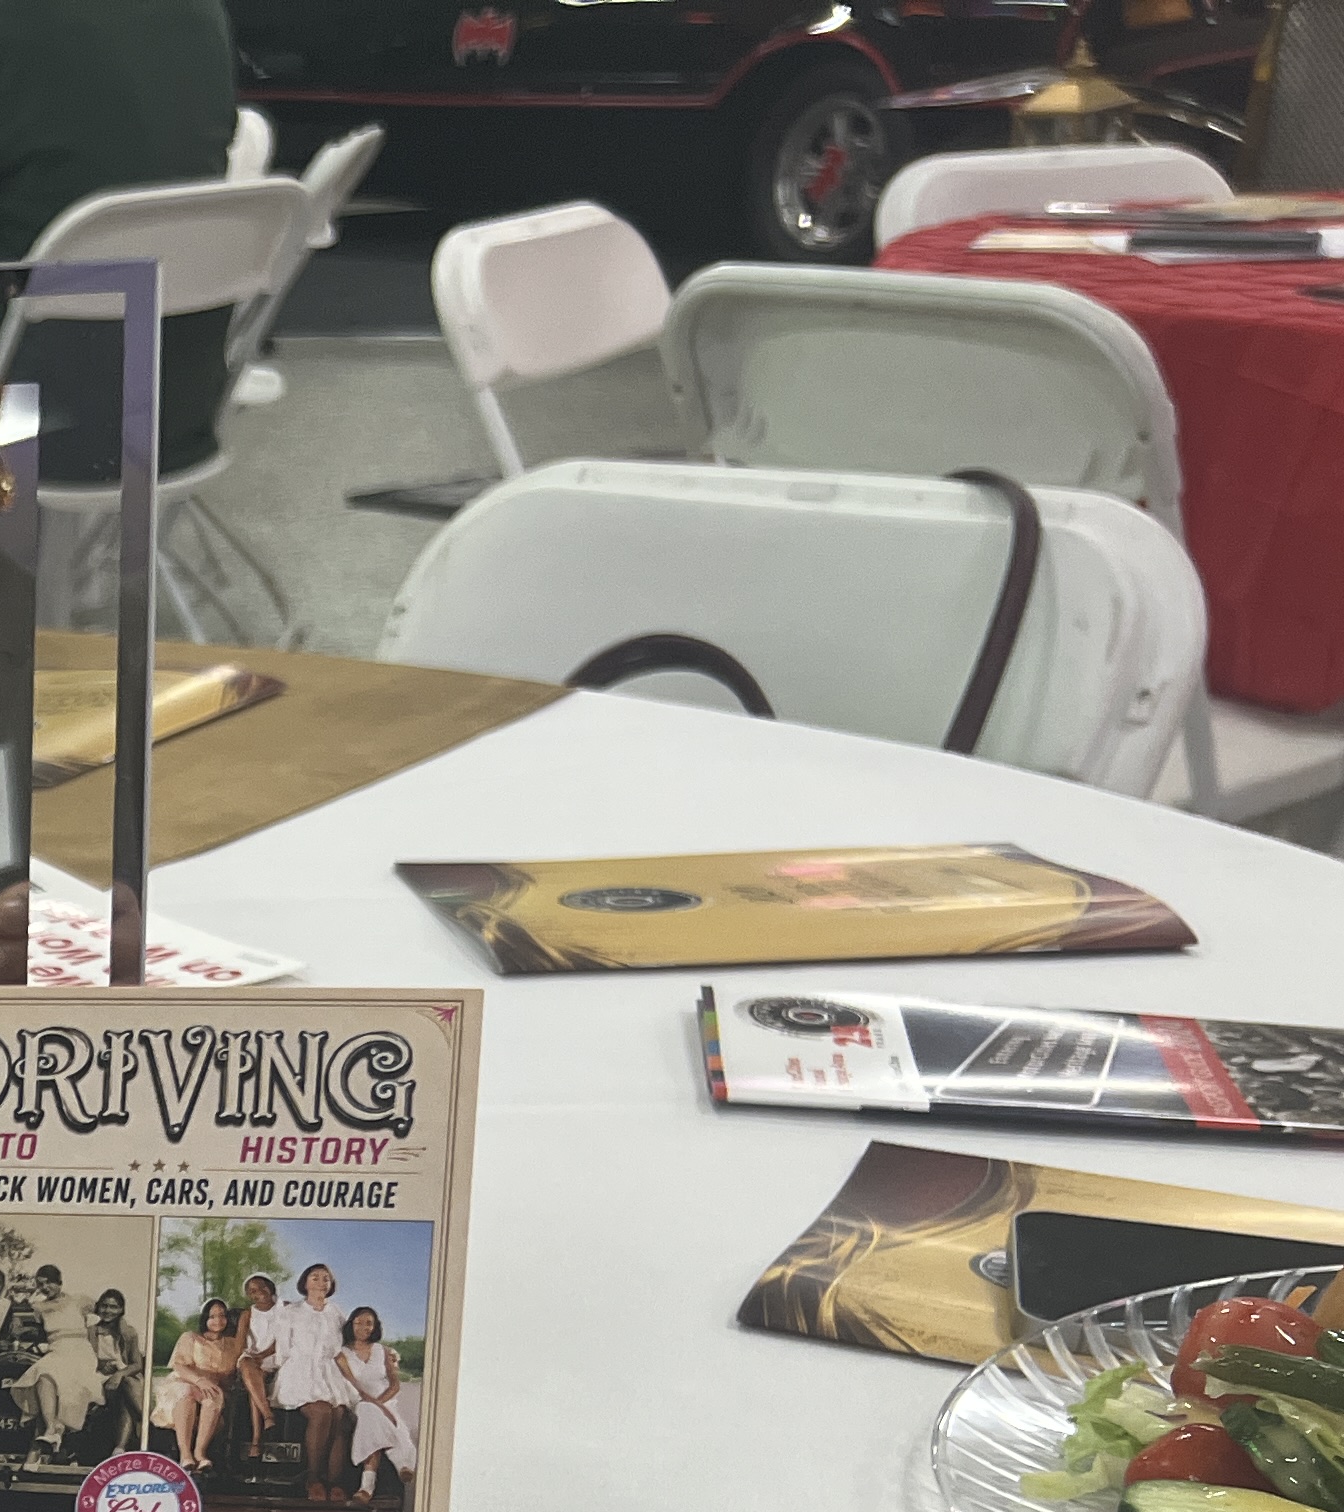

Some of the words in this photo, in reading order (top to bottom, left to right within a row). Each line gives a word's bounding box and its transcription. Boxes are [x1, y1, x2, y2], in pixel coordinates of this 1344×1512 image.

[239, 1136, 389, 1166] HISTORY
[37, 1176, 136, 1209] WOMEN,
[145, 1177, 214, 1209] CARS,
[223, 1180, 274, 1206] AND
[282, 1180, 398, 1209] COURAGE
[93, 1458, 142, 1485] Merze
[147, 1456, 178, 1482] Tate
